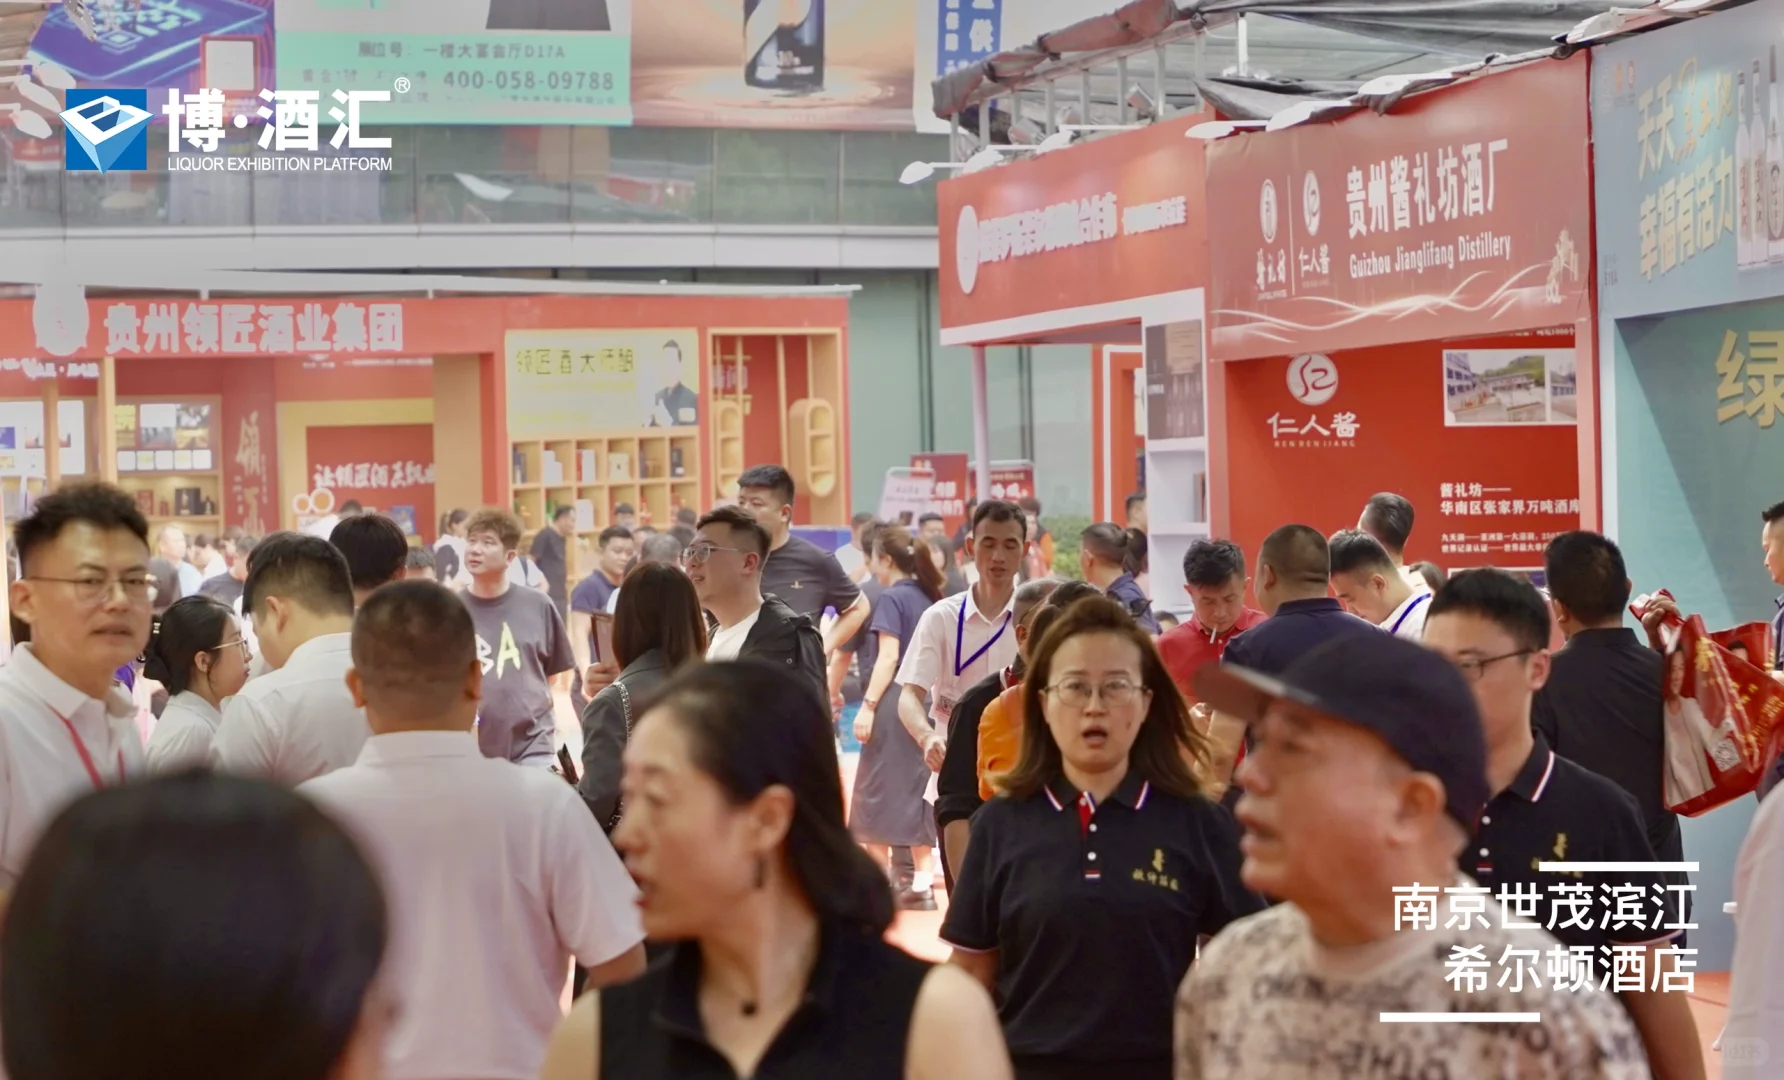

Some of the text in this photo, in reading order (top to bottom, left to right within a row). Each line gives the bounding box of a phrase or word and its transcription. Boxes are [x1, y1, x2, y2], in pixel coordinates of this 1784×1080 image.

[442, 70, 615, 91] 400-058-09788
[1346, 138, 1508, 240] 贵州酱礼坊酒厂
[1638, 147, 1735, 282] 幸福有活力
[1298, 243, 1331, 278] 仁人酱
[1349, 231, 1511, 279] Guizhou Jianglifang Distillery
[104, 302, 403, 354] 贵州领匠酒业集团
[1266, 411, 1361, 439] 仁人酱
